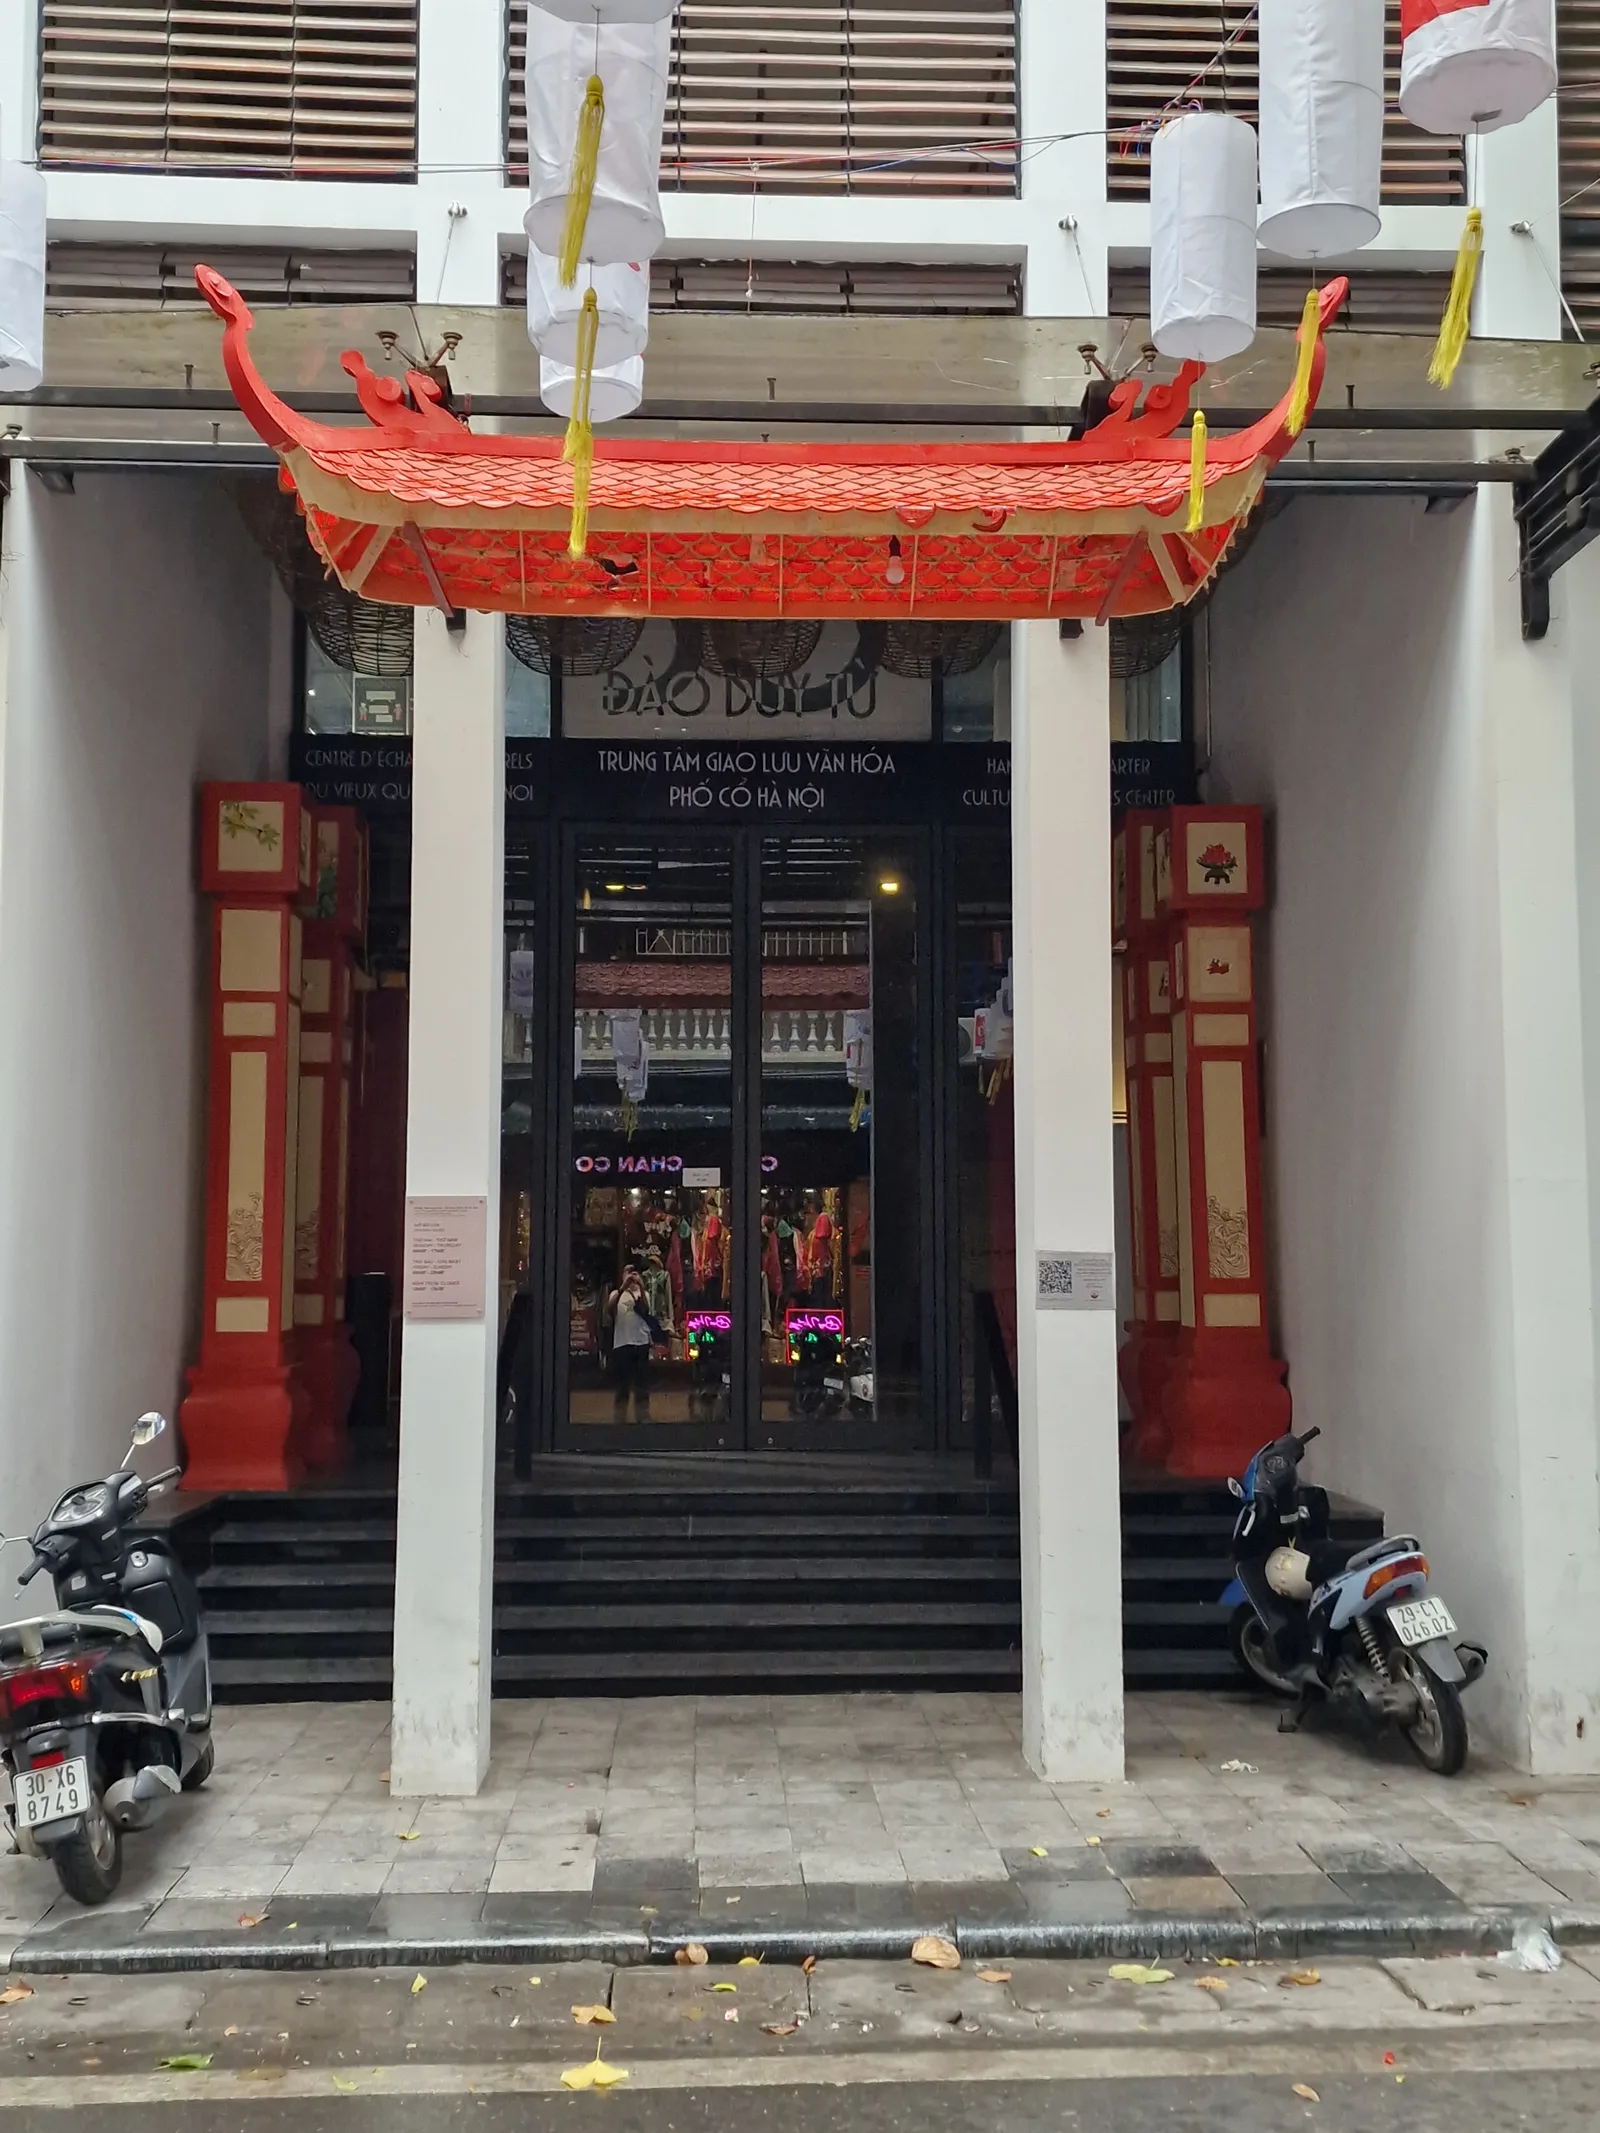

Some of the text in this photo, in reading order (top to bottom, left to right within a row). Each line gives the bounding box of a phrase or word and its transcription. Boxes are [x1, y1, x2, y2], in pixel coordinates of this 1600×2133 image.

[603, 655, 710, 717] ĐÀO
[725, 671, 810, 718] DUY
[305, 751, 355, 767] CENTRE
[598, 750, 657, 772] TRUNG
[663, 747, 700, 772] TÂM
[706, 751, 756, 772] GIAO
[806, 748, 845, 773] VĂN
[851, 746, 896, 773] HÓA
[334, 782, 377, 798] VIEUX
[669, 777, 825, 813] PHỐ CỔ HÀ NỘI
[1124, 789, 1175, 806] CENTER
[25, 1765, 76, 1797] 30-X6
[27, 1789, 79, 1821] 8749
